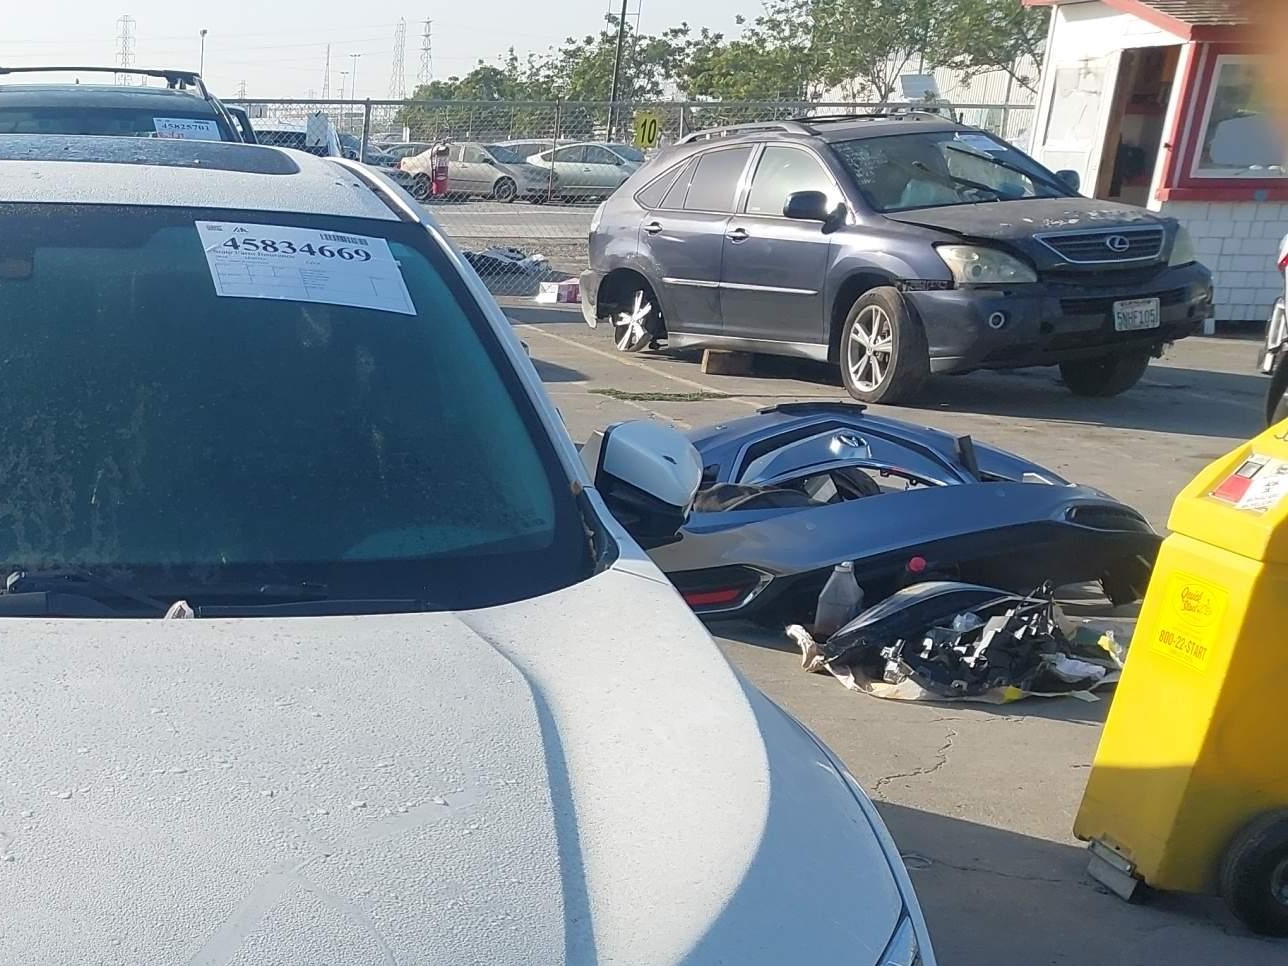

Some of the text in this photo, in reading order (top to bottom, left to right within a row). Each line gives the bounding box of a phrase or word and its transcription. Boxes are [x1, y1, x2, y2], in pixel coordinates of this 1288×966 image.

[641, 118, 657, 144] 10
[222, 236, 372, 262] 45834669
[1158, 629, 1208, 660] 800-22-START
